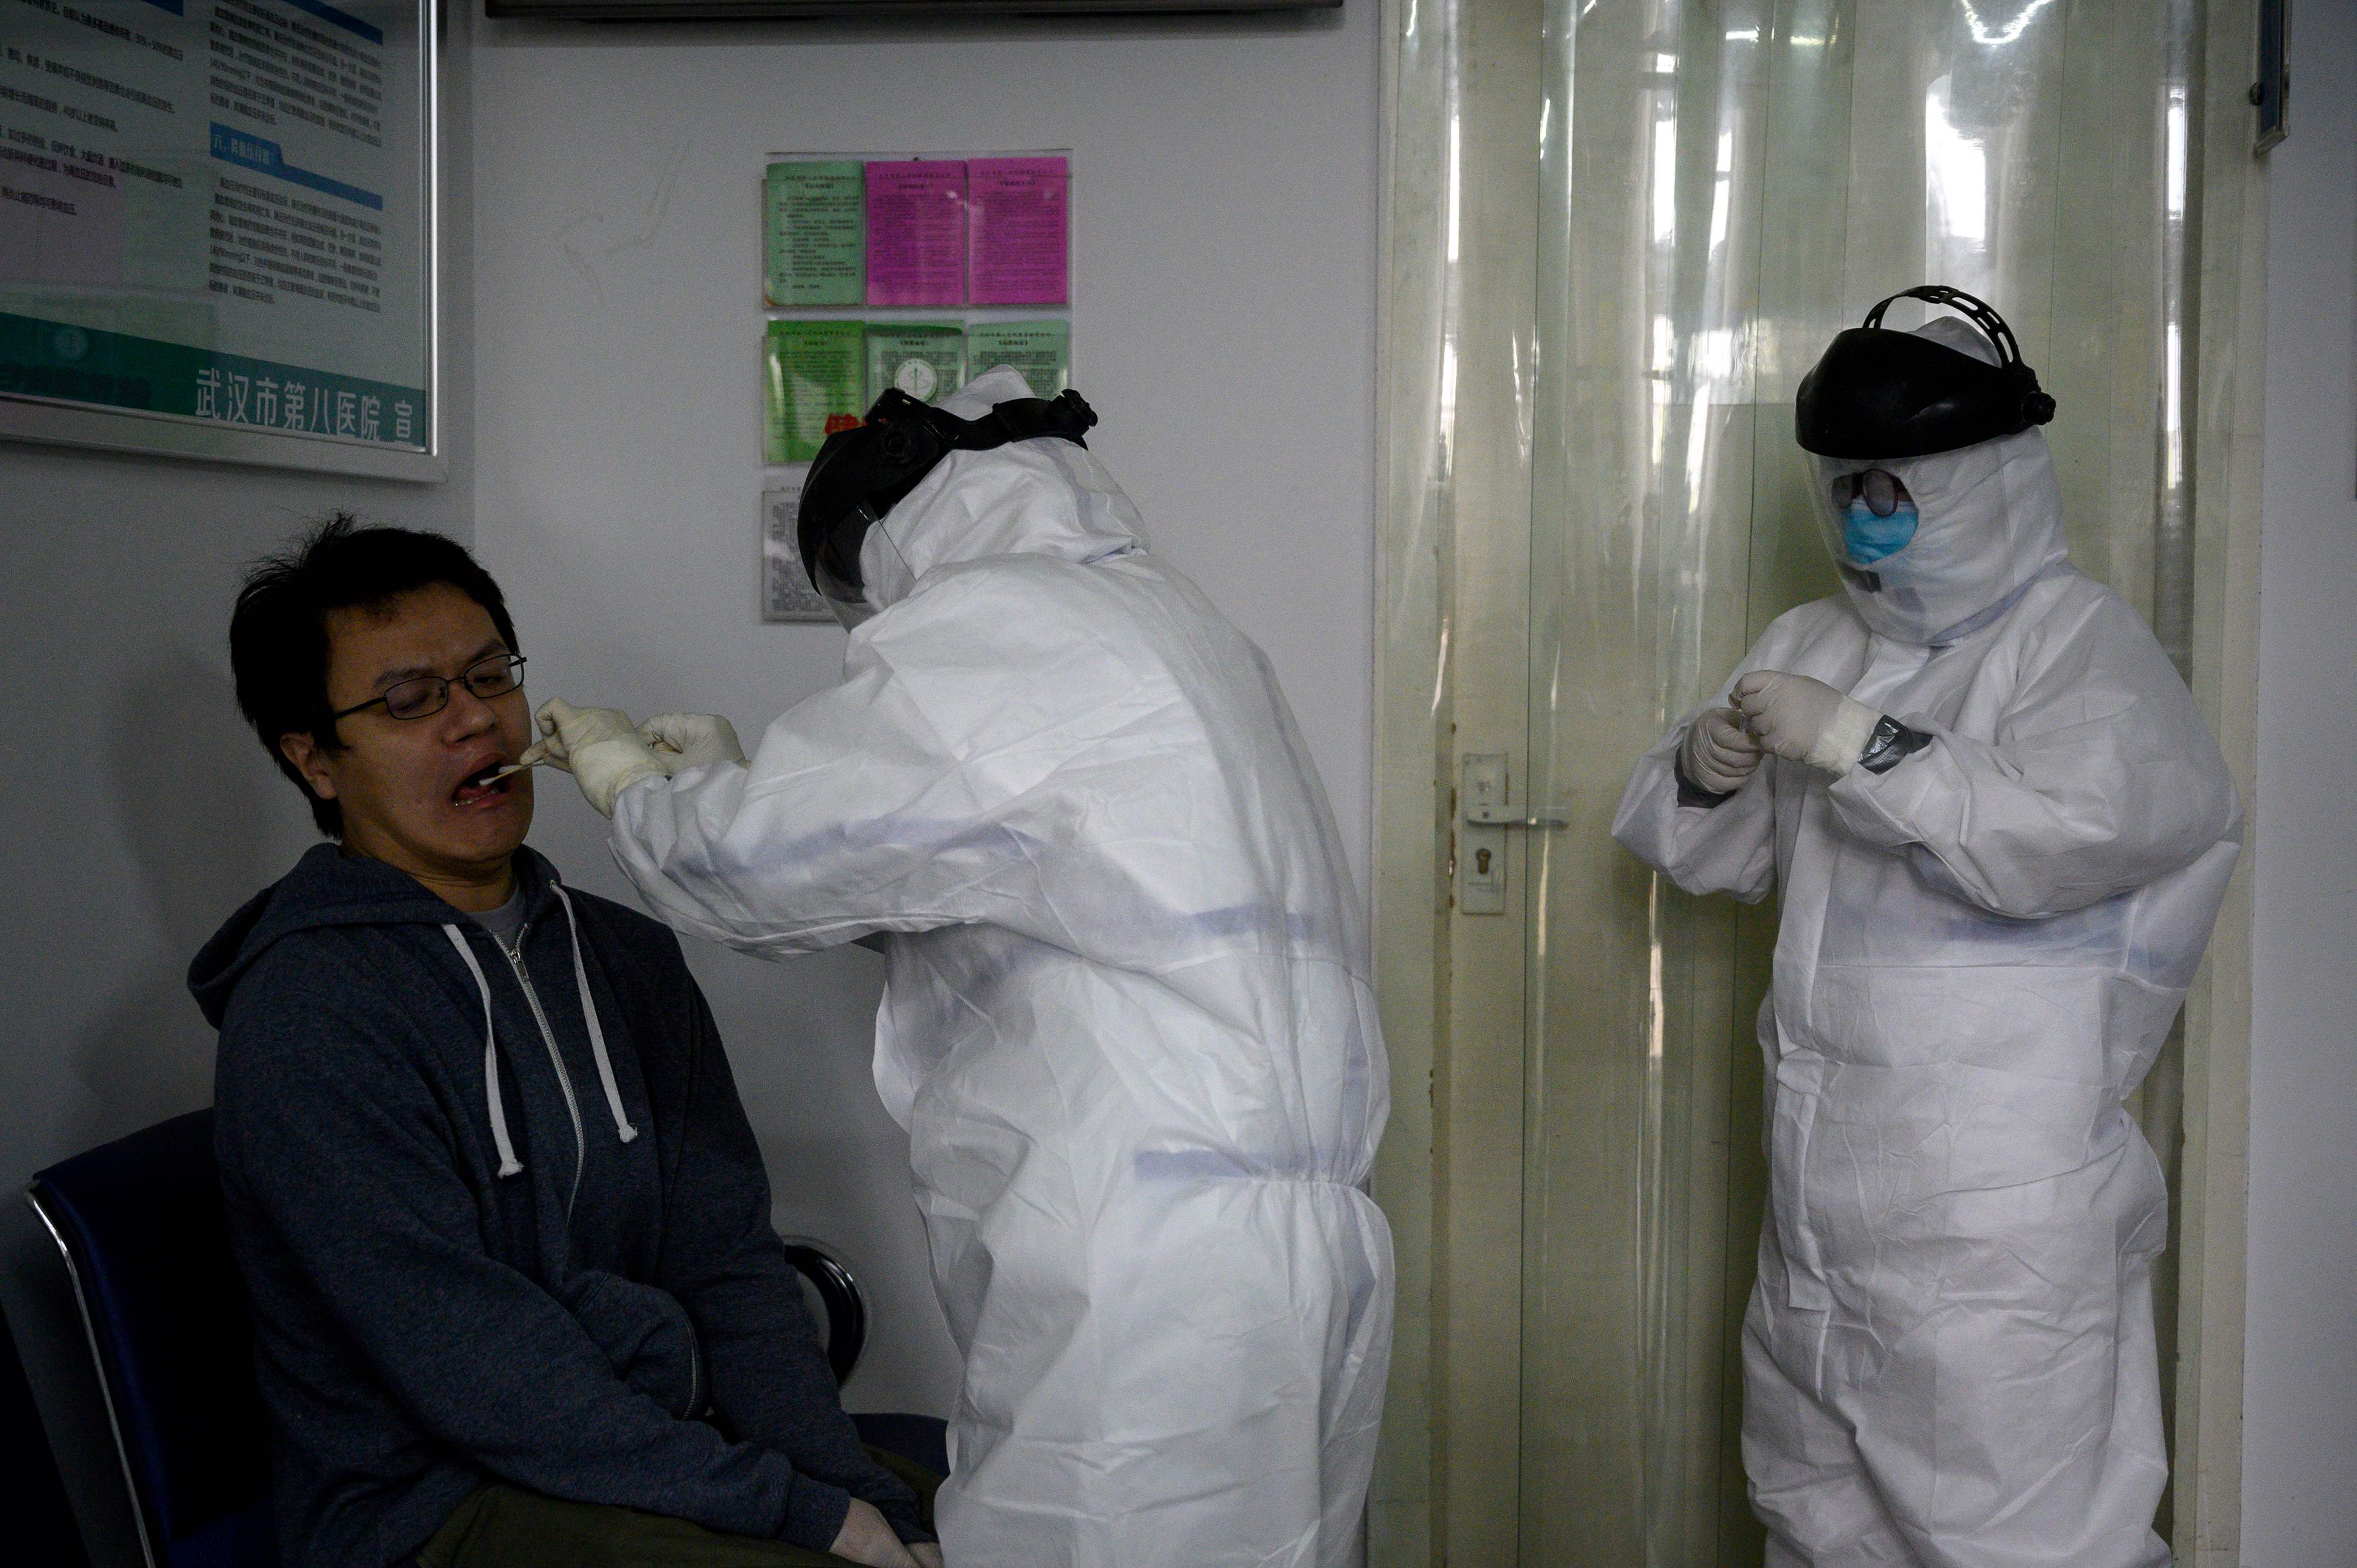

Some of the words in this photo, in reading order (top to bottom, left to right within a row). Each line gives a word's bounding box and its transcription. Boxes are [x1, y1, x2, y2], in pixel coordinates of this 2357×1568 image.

[195, 368, 381, 441] 武汉市第八医院
[394, 400, 412, 443] 宣
